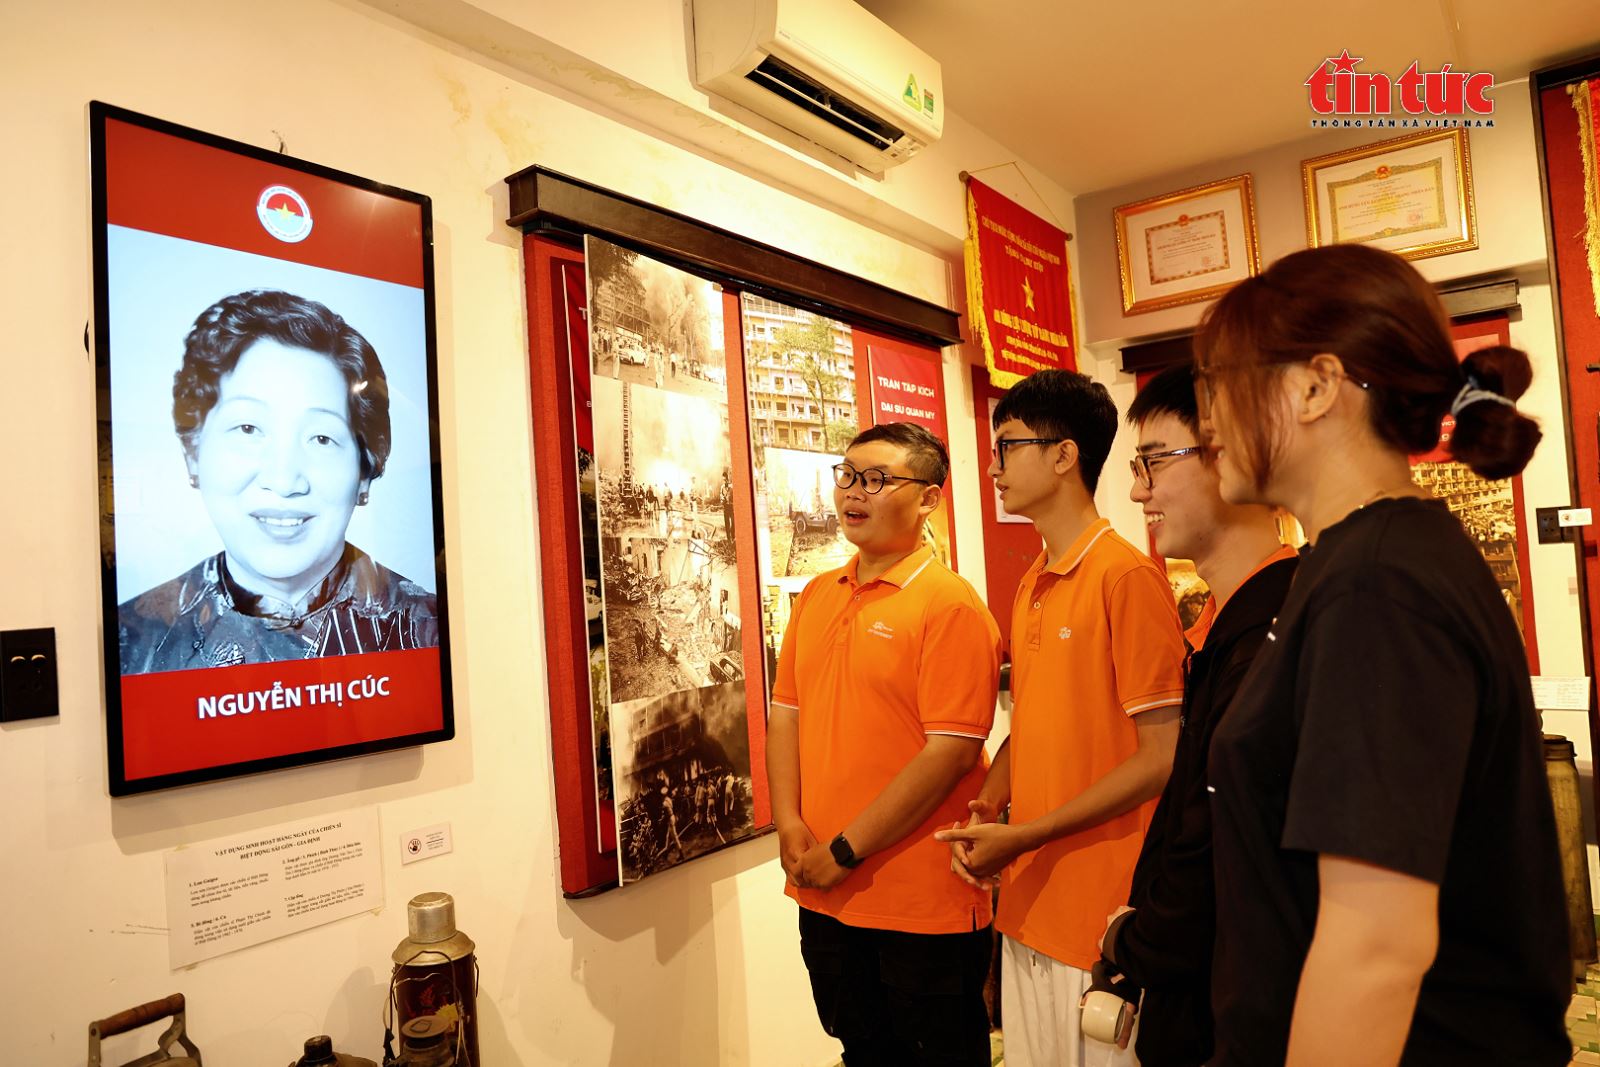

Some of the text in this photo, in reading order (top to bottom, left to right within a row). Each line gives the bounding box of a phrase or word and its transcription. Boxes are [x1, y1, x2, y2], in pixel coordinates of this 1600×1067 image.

[197, 674, 390, 719] NGUYỄN THỊ CÚC
